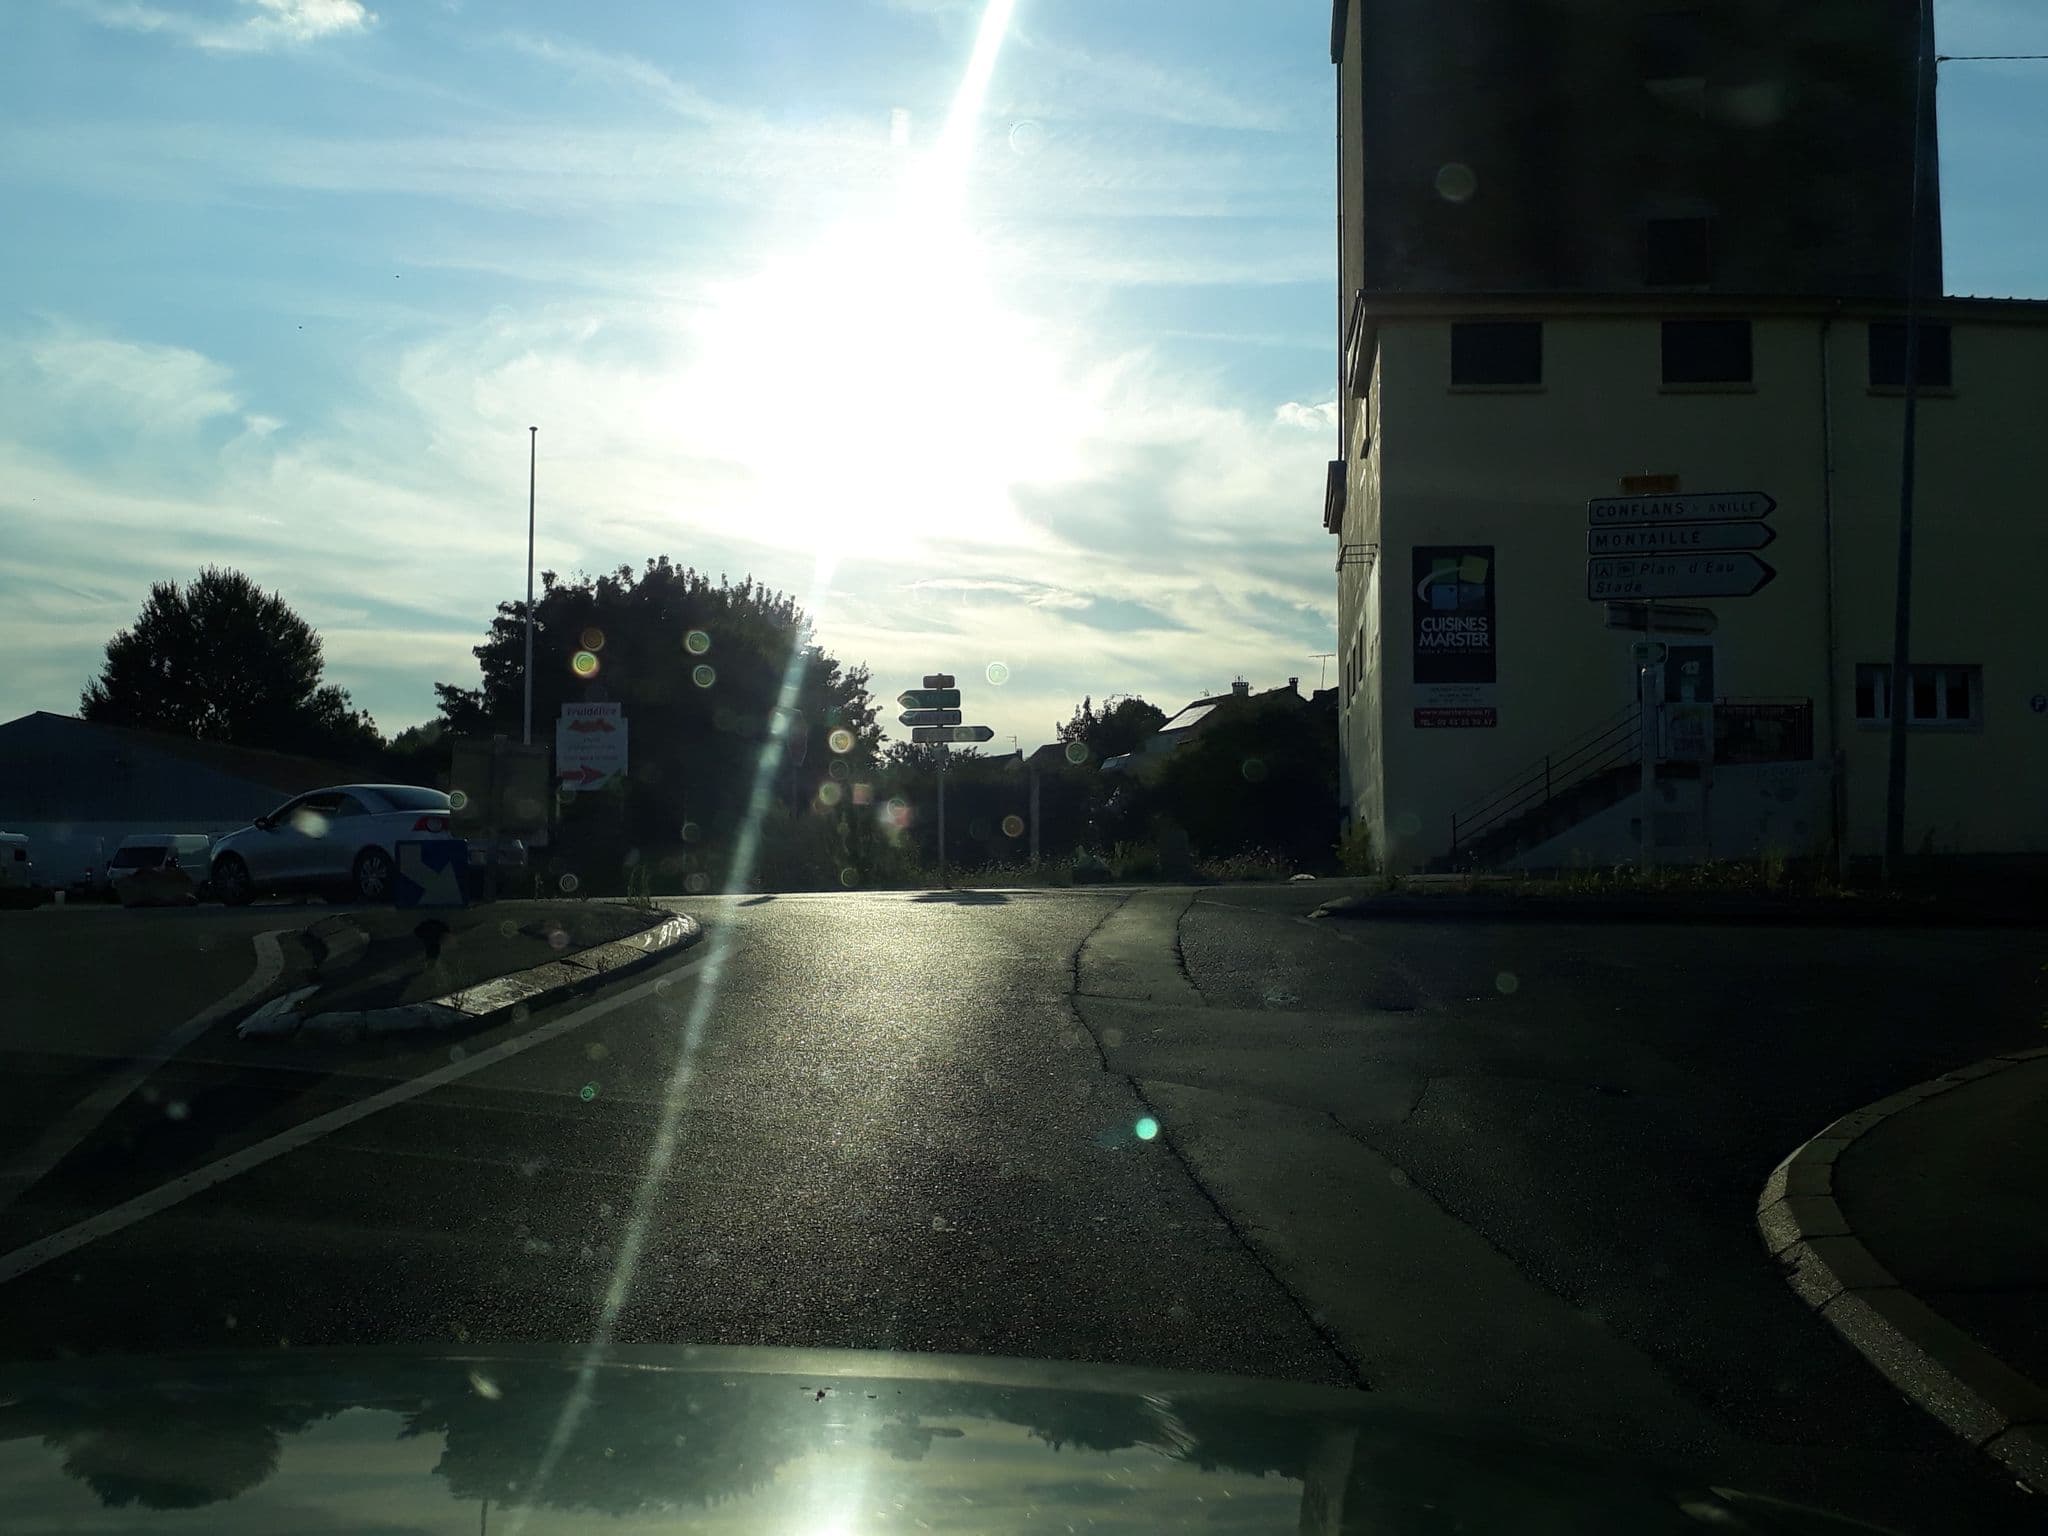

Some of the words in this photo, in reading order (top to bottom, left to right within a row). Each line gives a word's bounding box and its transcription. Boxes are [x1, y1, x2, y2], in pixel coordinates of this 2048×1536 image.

[1596, 503, 1684, 518] CONFLANS
[1595, 532, 1701, 547] MONTAILLE
[1639, 562, 1676, 576] Plan
[1595, 582, 1643, 594] Stade
[1420, 617, 1488, 632] CUISINES
[1418, 632, 1489, 647] MARSTER
